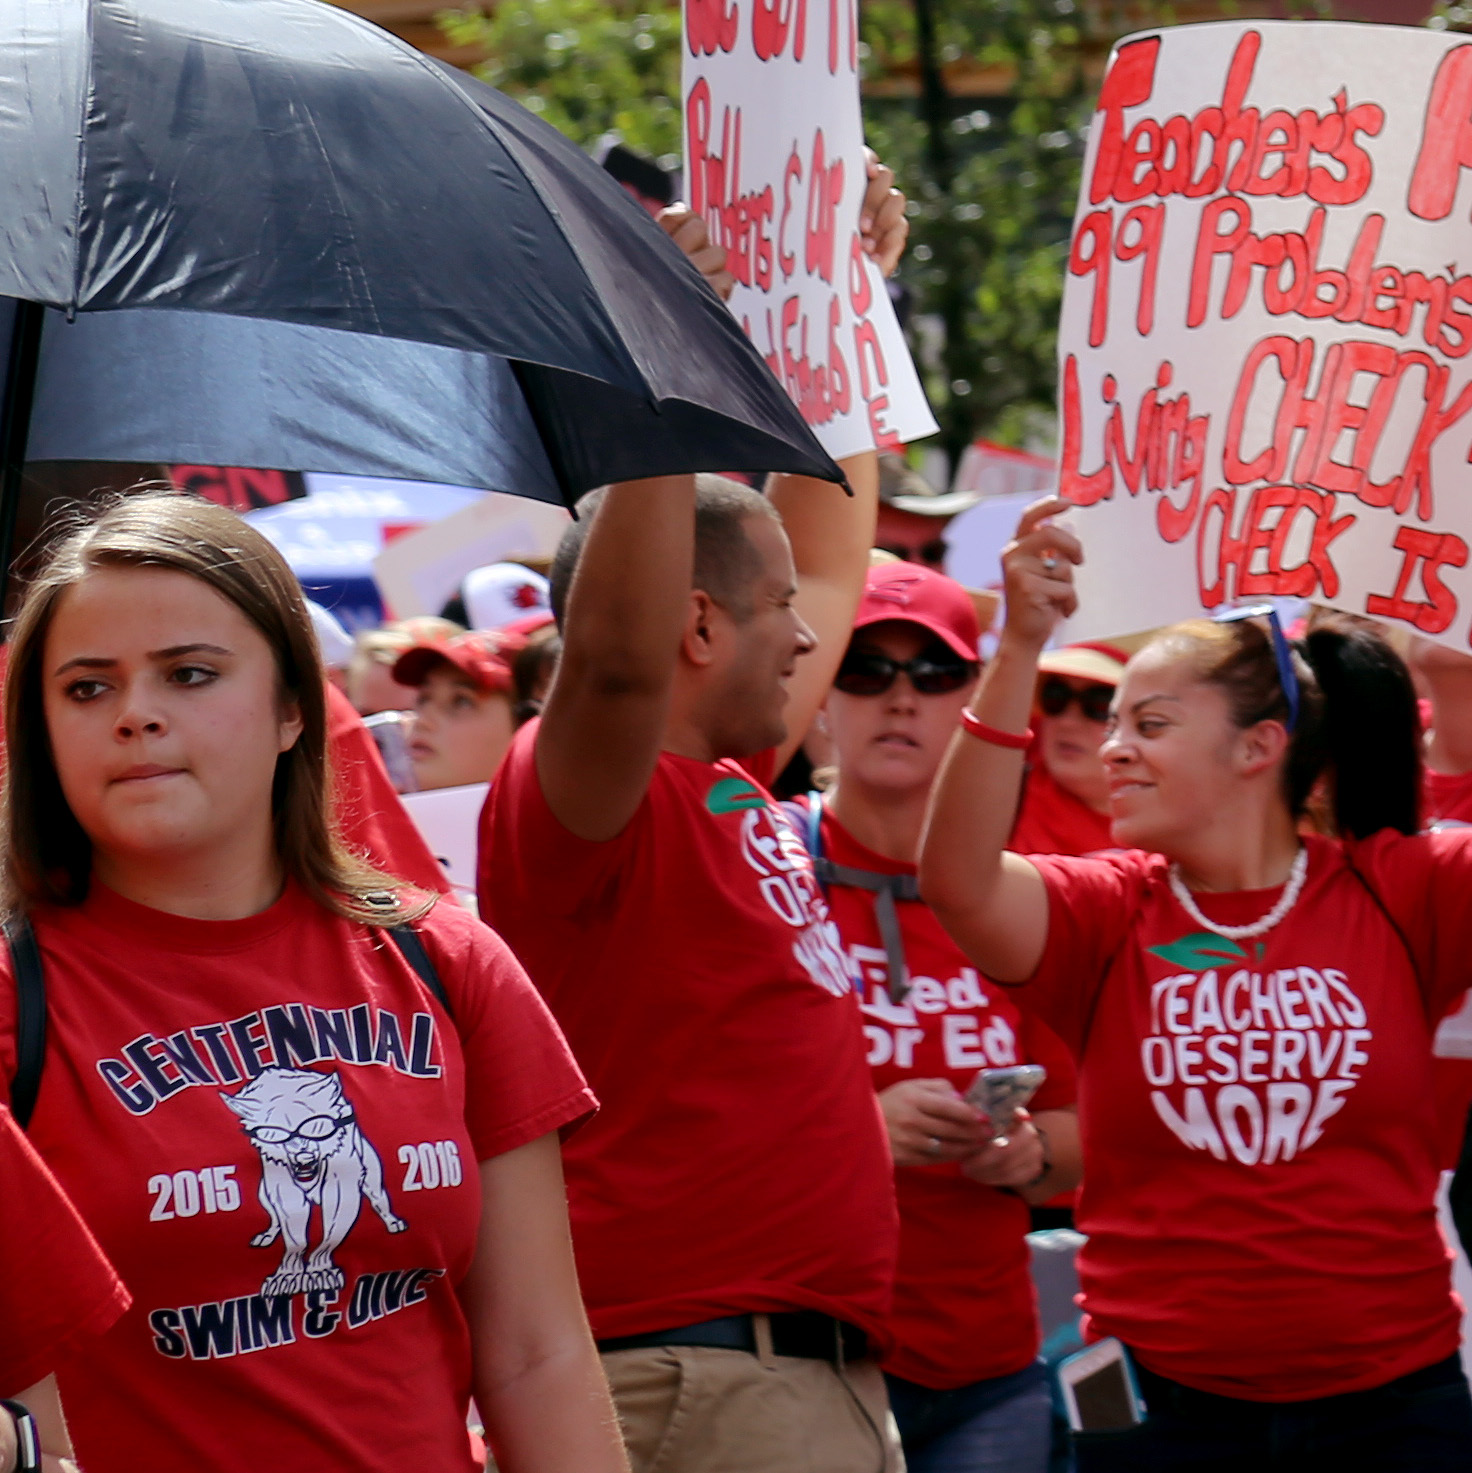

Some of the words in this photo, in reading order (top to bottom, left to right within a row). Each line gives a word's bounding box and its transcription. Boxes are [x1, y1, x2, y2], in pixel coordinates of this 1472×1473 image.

[1087, 29, 1386, 207] Teacher's
[1069, 202, 1168, 348] 99
[1058, 353, 1211, 545] Living
[1199, 484, 1358, 609] CHECK
[1365, 526, 1470, 635] IS
[942, 1014, 1017, 1070] Ed
[1150, 965, 1368, 1035] TEACHERS
[95, 1002, 442, 1117] CENTENNIAL
[1140, 1028, 1373, 1087] DESERVE
[1150, 1079, 1358, 1166] MORE
[147, 1165, 242, 1223] 2015
[148, 1292, 297, 1361] SWIM
[302, 1287, 340, 1338] &
[348, 1267, 446, 1330] DIVE
